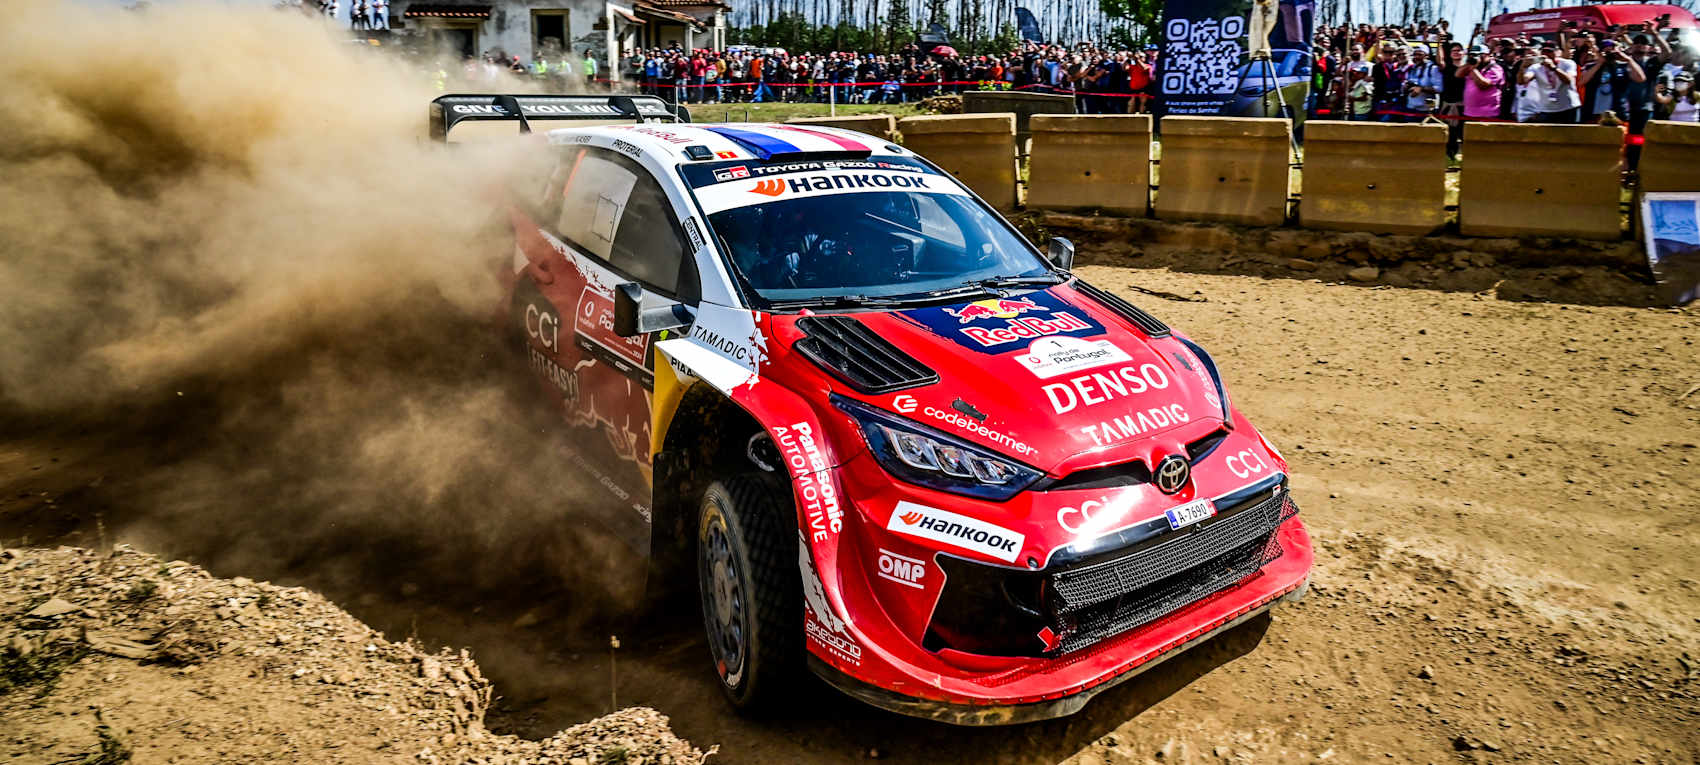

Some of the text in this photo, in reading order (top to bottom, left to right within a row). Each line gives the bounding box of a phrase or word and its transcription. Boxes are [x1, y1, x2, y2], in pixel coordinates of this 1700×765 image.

[523, 104, 571, 114] YOU
[612, 139, 644, 158] PROTERIAL
[753, 162, 819, 175] TOYOTA
[823, 161, 876, 170] GAZOO
[878, 161, 924, 173] Racing
[693, 325, 747, 360] TAMADIC
[670, 356, 696, 378] PIAA
[1042, 363, 1169, 415] DENSO
[923, 405, 1036, 456] codebeamer
[1081, 403, 1190, 446] TAMADIC
[773, 426, 829, 543] AUTOMOTIVE
[791, 421, 844, 534] Panasonic
[1177, 503, 1208, 523] A-7690
[878, 554, 926, 584] OMP
